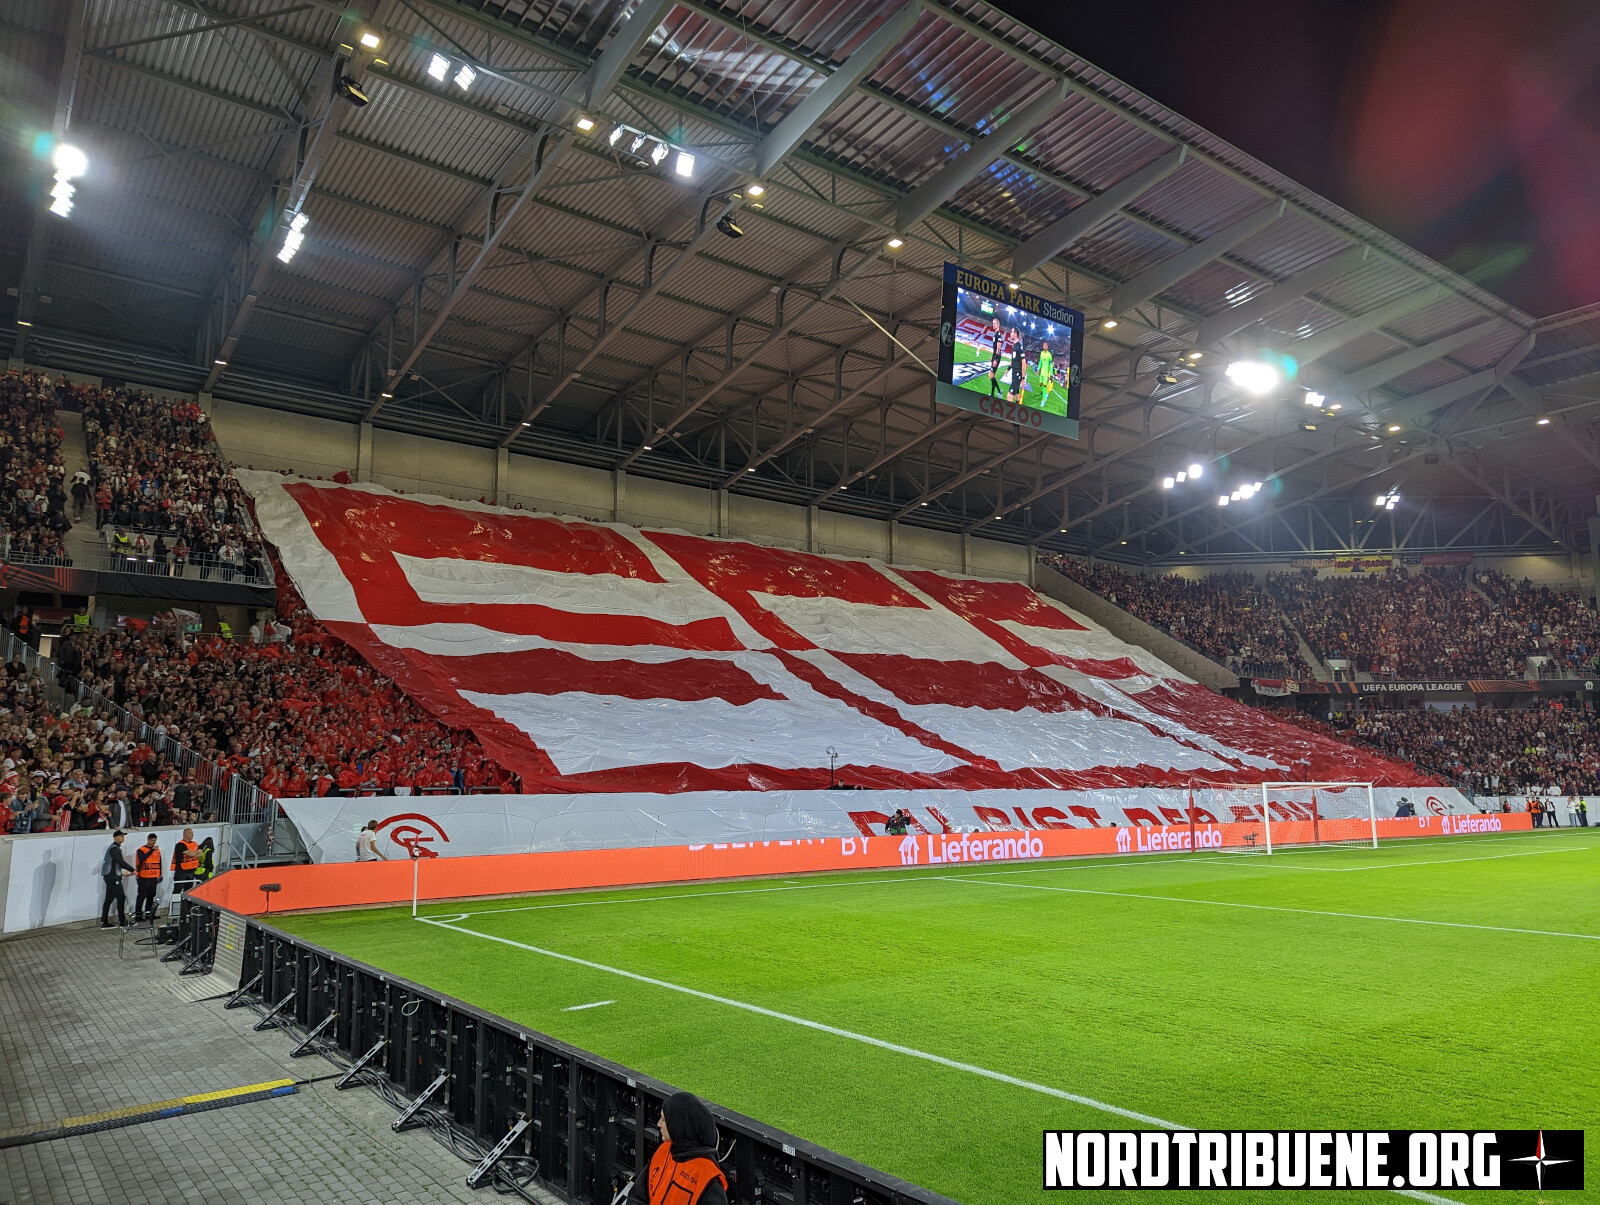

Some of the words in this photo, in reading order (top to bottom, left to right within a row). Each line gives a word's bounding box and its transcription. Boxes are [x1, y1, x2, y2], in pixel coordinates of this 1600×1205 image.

[956, 269, 1005, 301] EUROPA
[1010, 289, 1040, 313] PARK
[1043, 302, 1074, 325] Stadion
[979, 396, 1042, 427] CAZOO
[1362, 684, 1387, 692] UEFA
[1388, 683, 1425, 692] EUROPA
[1426, 683, 1463, 691] LEAGUE
[1137, 823, 1222, 851] Lieferando
[1453, 814, 1502, 833] Lieferando
[841, 836, 870, 856] BY
[928, 831, 1044, 863] Lieferando
